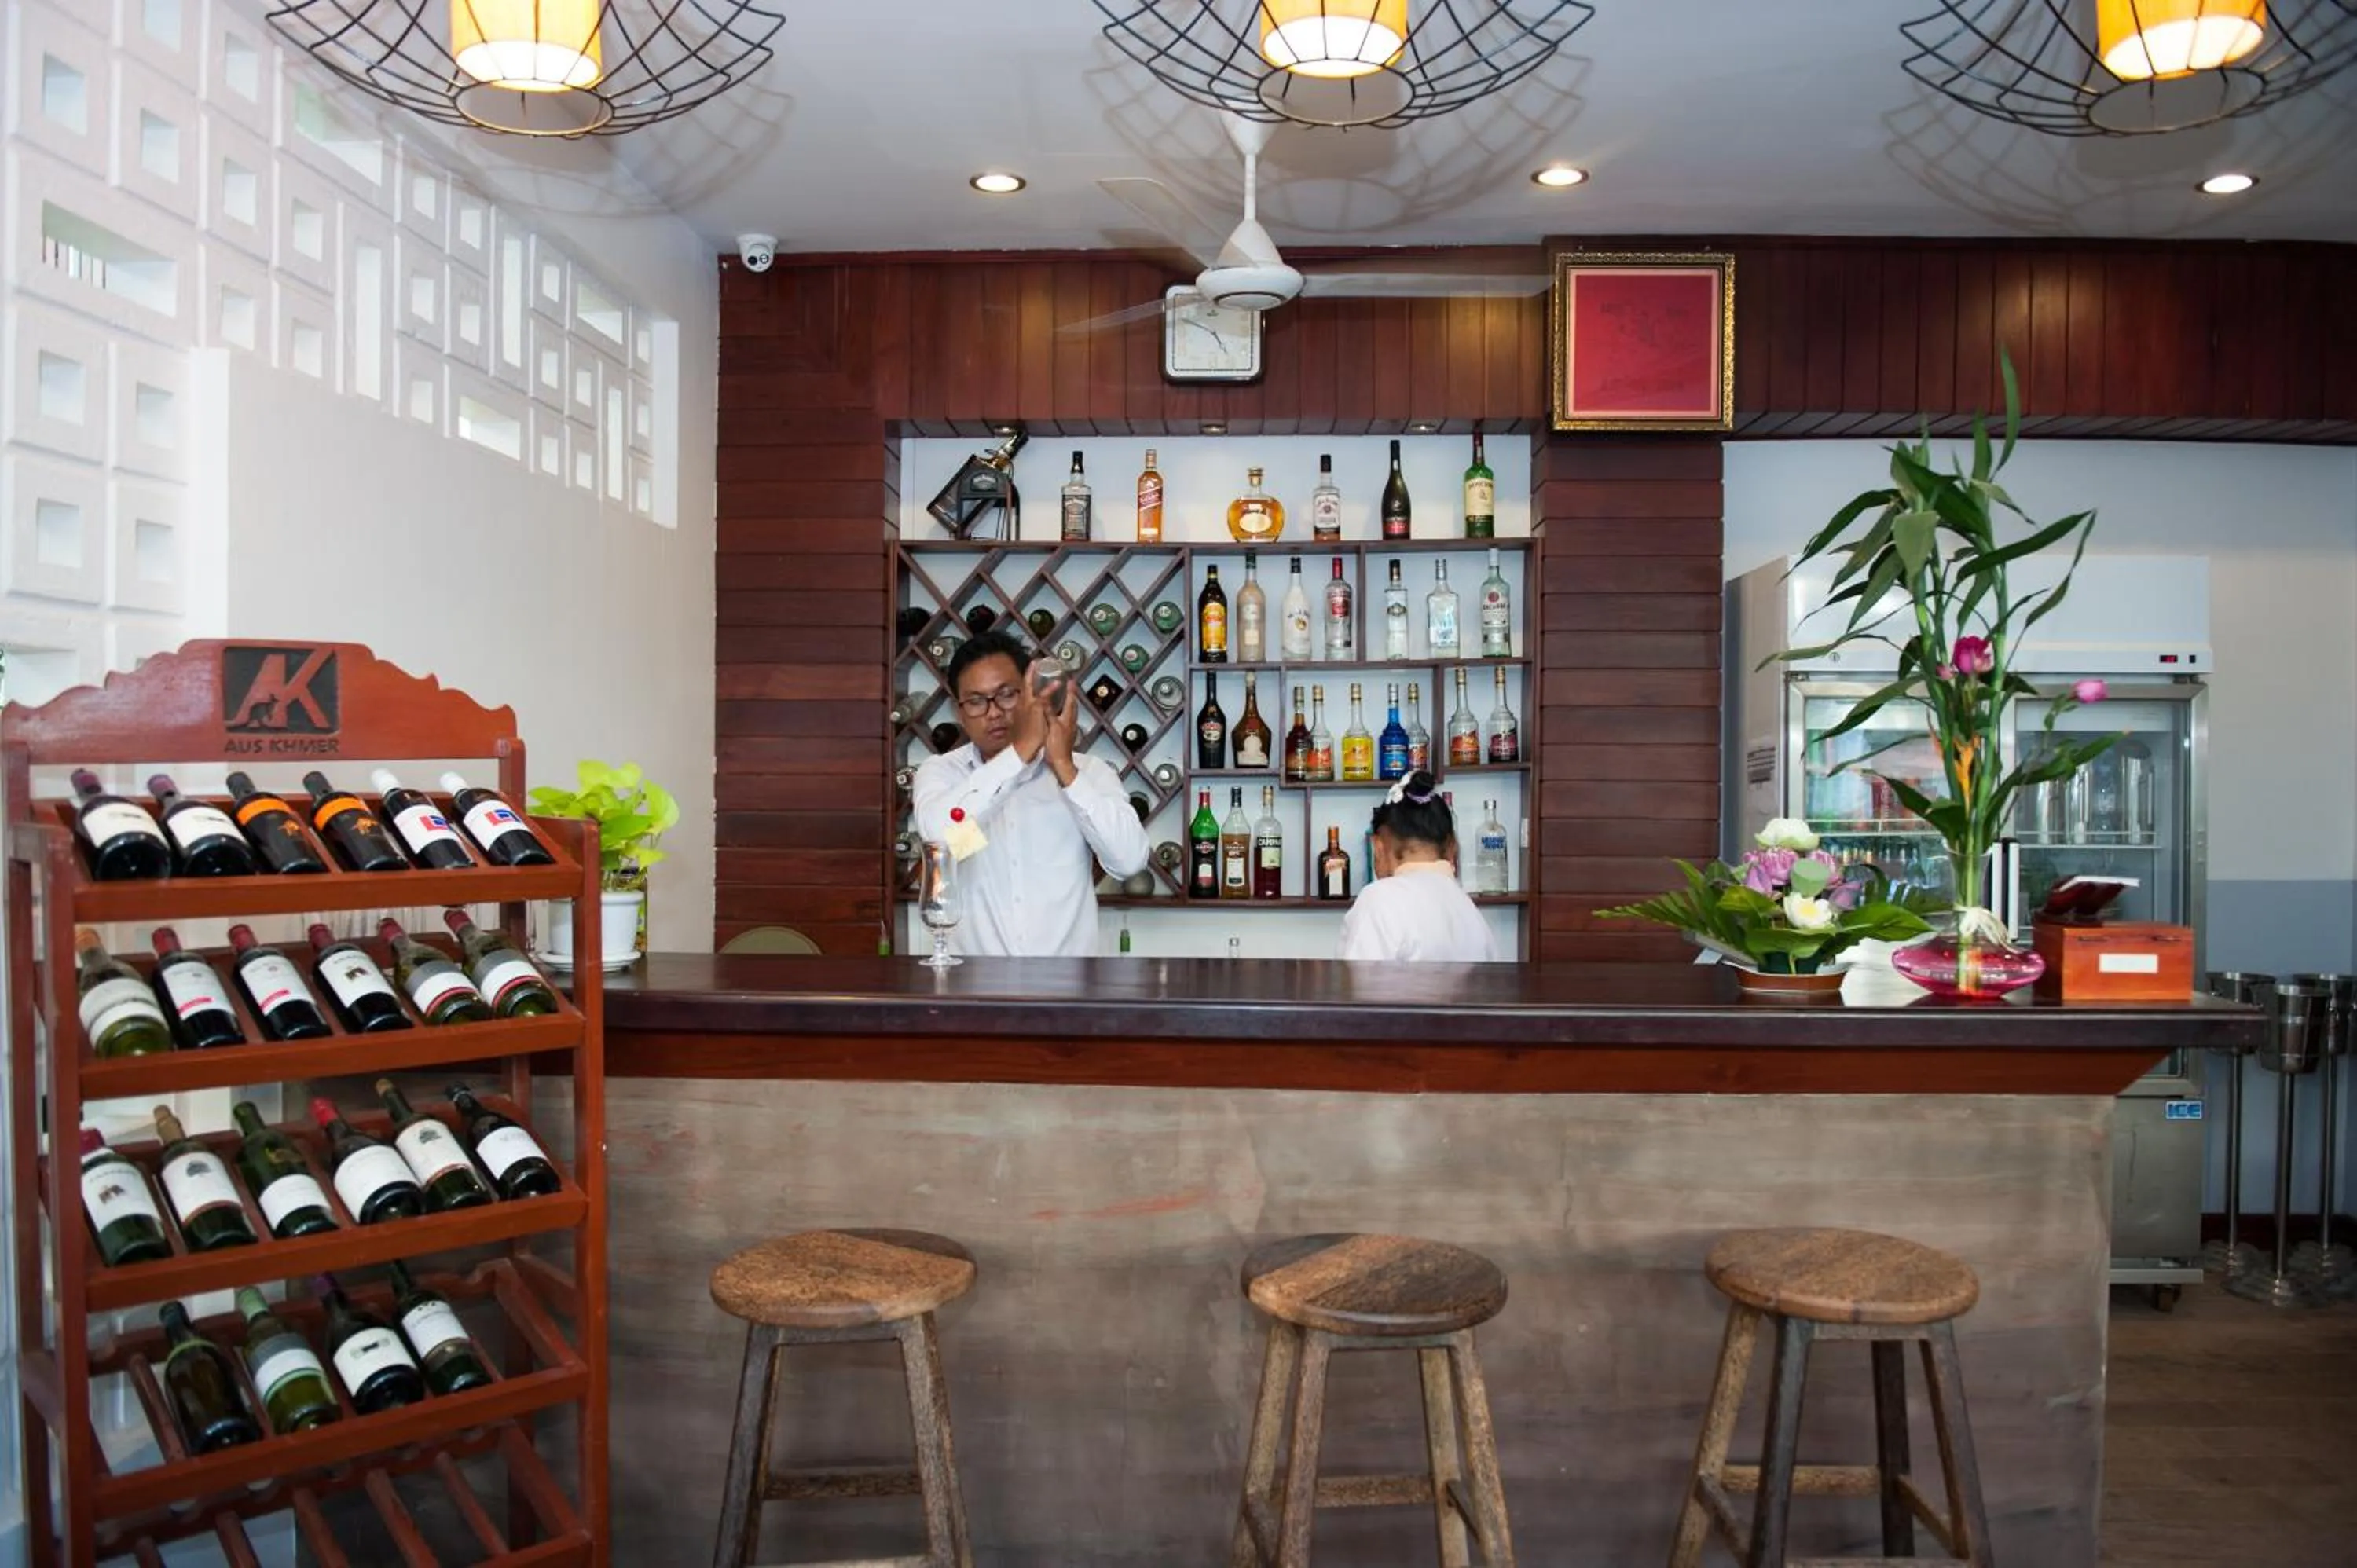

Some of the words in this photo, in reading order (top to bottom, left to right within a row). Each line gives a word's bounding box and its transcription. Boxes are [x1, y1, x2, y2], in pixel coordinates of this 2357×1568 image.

[225, 647, 334, 729] AK
[224, 738, 262, 753] AUS
[269, 738, 339, 753] KHMER
[2168, 1104, 2201, 1118] ICE
